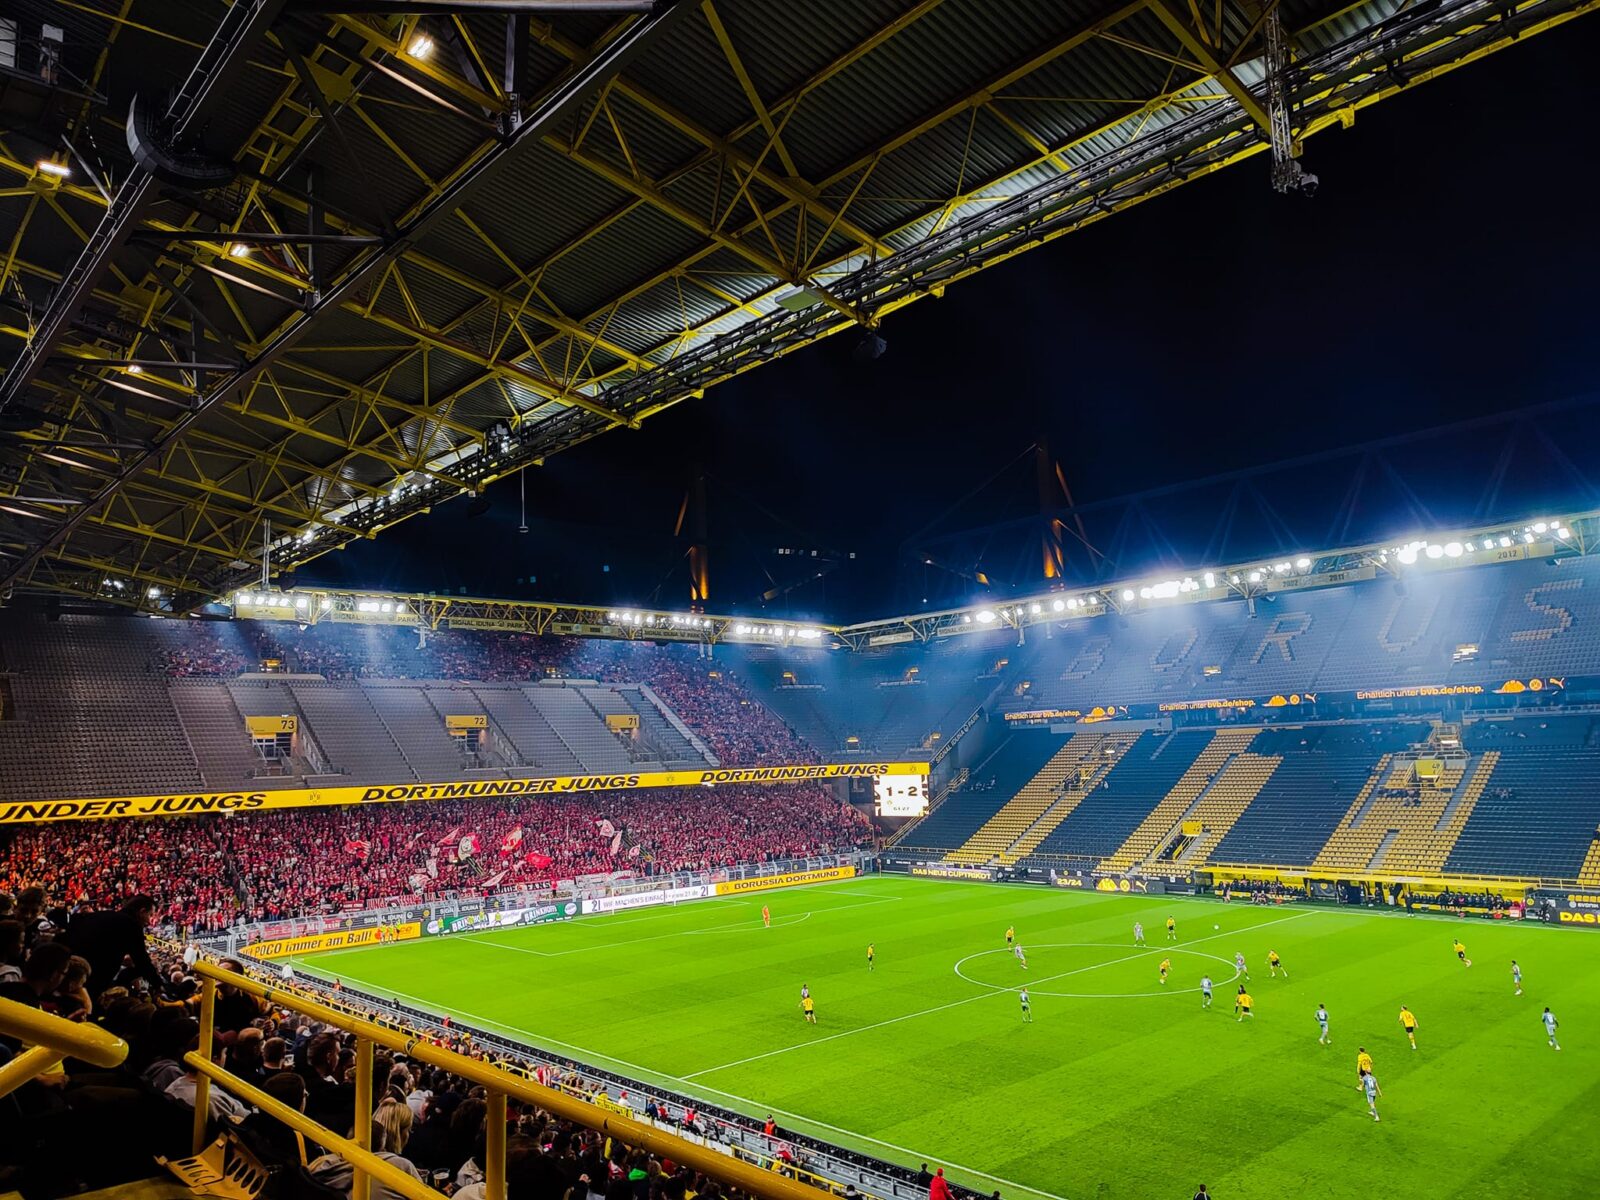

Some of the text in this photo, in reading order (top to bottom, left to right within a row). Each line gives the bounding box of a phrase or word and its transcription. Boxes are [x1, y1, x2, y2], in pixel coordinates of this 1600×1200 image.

[281, 719, 295, 730] 73
[474, 717, 484, 725] 72
[628, 717, 637, 726] 71
[700, 764, 889, 783] DORTMUNDER JUNGS
[361, 775, 640, 801] DORTMUNDER JUNGS
[886, 787, 892, 796] 1
[908, 786, 918, 797] 2
[138, 793, 267, 813] JUNGS
[912, 868, 928, 876] DAS
[734, 876, 784, 890] BORUSSIA
[786, 870, 840, 883] DORTMUND
[1560, 911, 1596, 923] DAS
[254, 942, 282, 958] POCO
[286, 939, 322, 953] immer
[326, 936, 344, 947] am
[346, 930, 371, 944] Ball!
